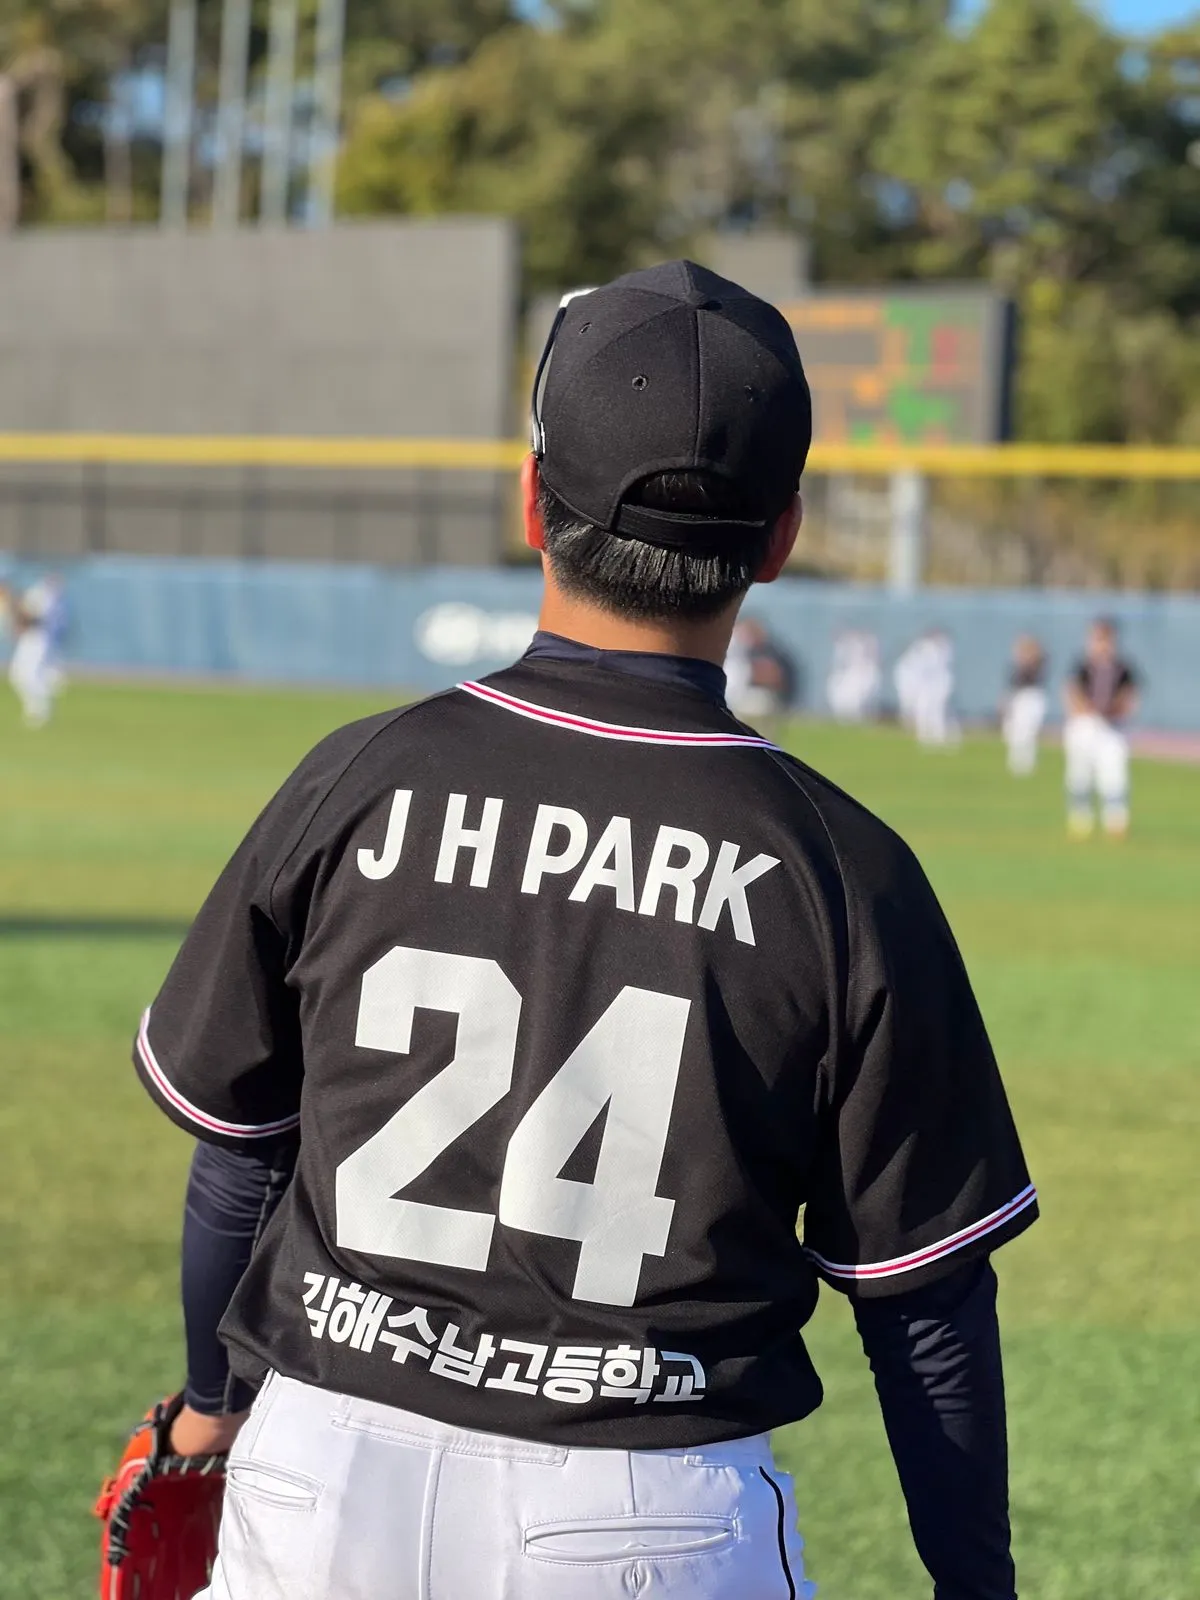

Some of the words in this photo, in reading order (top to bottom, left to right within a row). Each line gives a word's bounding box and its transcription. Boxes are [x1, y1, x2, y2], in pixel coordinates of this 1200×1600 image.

[357, 789, 413, 880] J
[434, 793, 503, 888] H
[521, 804, 781, 946] PARK
[335, 946, 691, 1307] 24
